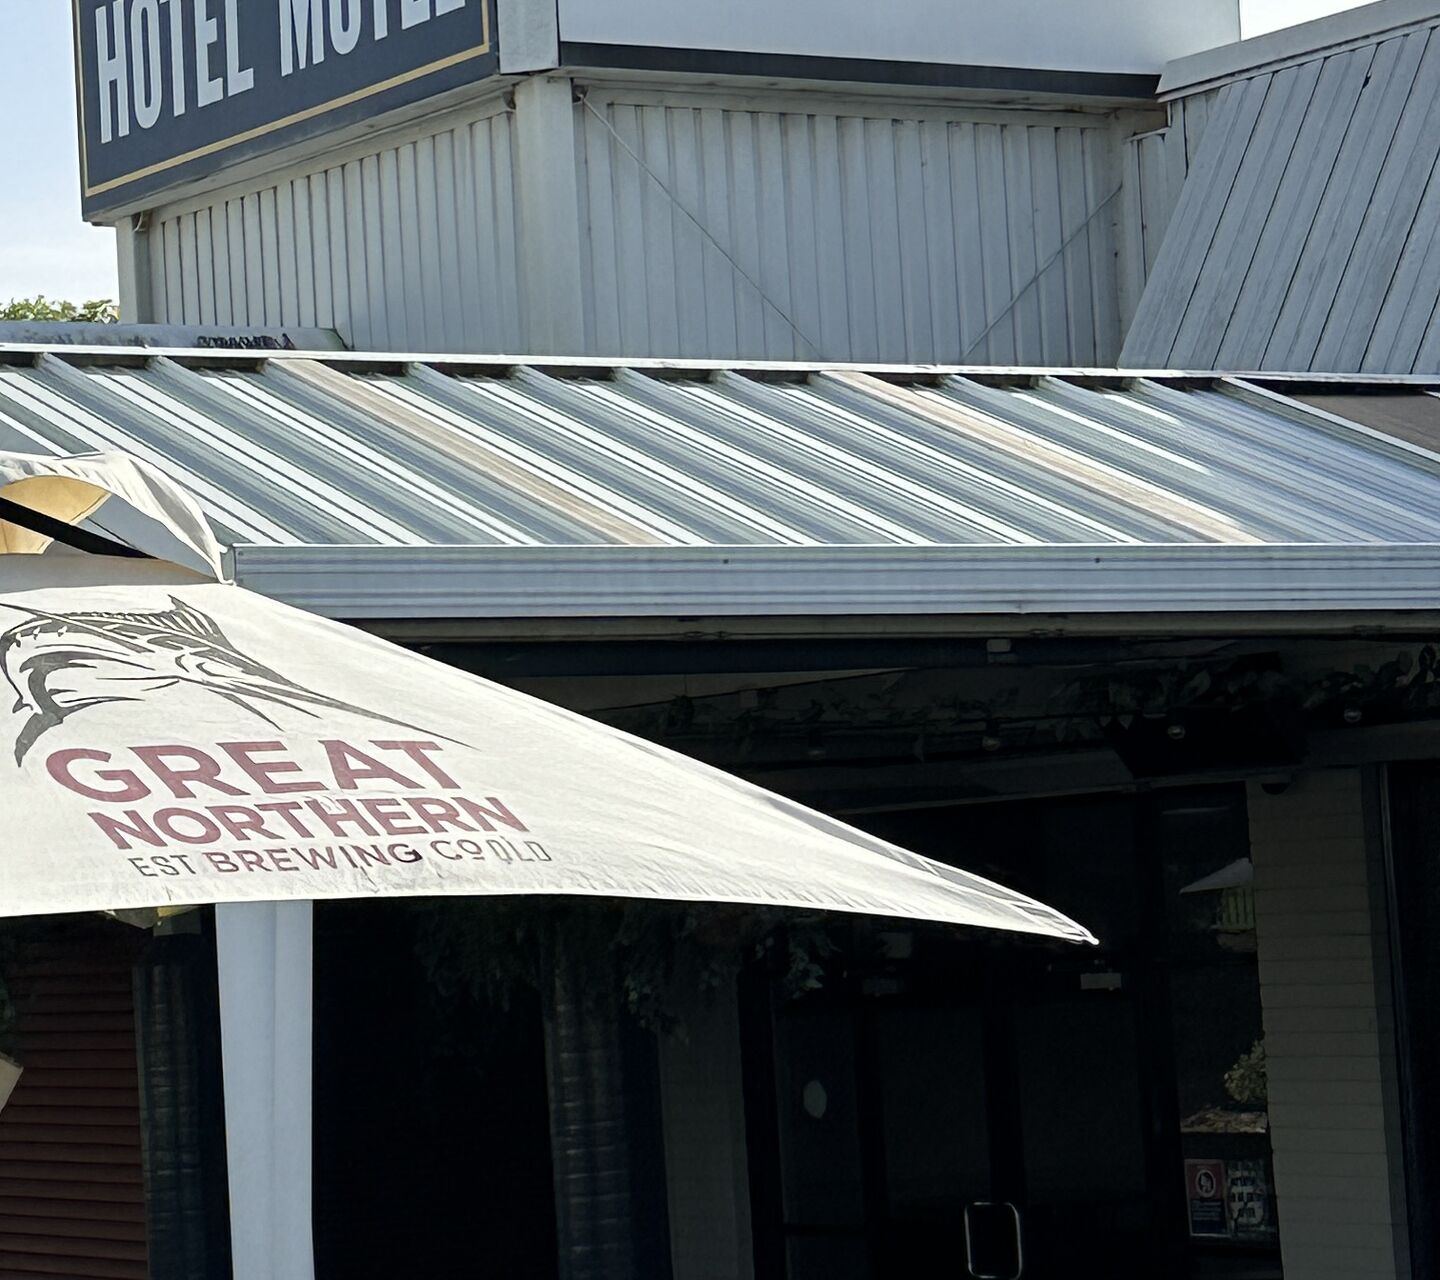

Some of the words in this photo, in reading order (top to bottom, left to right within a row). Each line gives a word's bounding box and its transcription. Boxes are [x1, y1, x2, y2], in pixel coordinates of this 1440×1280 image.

[45, 739, 463, 803] GREAT
[86, 796, 531, 850] NORTHERN
[127, 853, 198, 878] EST
[202, 842, 424, 874] BREWING
